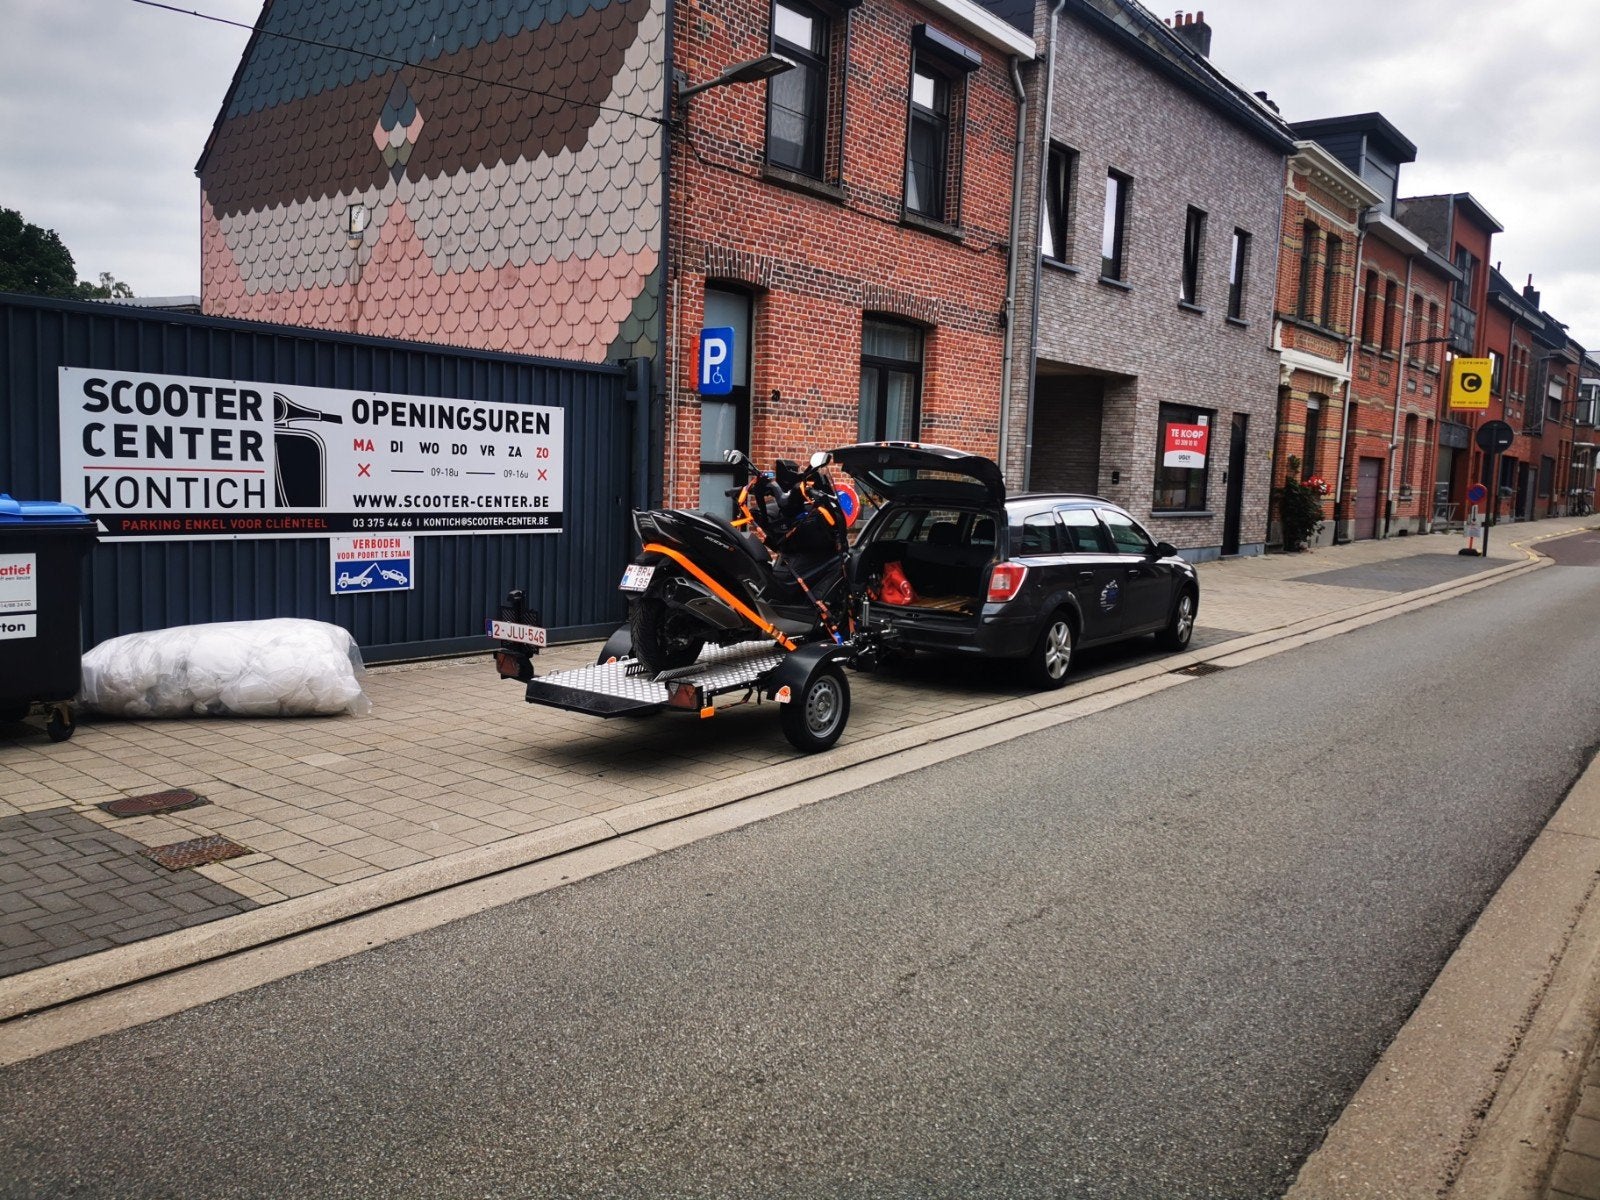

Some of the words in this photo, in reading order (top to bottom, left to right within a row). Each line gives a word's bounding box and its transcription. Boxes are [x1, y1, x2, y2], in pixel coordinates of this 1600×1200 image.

[703, 338, 727, 384] P
[82, 377, 264, 422] SCOOTER
[351, 398, 550, 435] OPENINGSUREN
[1171, 429, 1179, 437] TE
[1181, 430, 1203, 438] KOOP
[82, 422, 264, 462] CENTER
[353, 438, 375, 452] MA
[390, 440, 403, 453] DI
[419, 441, 440, 454] WO
[451, 443, 468, 455] DO
[480, 445, 495, 457] VR
[508, 446, 523, 458] ZA
[536, 447, 549, 459] ZO
[430, 467, 459, 477] 09-18u
[503, 469, 529, 479] 09-16u
[84, 475, 266, 509] KONTICH
[352, 494, 549, 508] WWW.SCOOTER-CENTER.BE
[122, 519, 182, 531] PARKING
[185, 519, 227, 530] ENKEL
[230, 518, 262, 529] VOOR
[265, 516, 328, 529] CLIËNTEEL
[352, 519, 364, 528] 03
[367, 518, 385, 527] 375
[387, 518, 399, 527] 44
[401, 518, 412, 527] 66
[423, 516, 549, 527] KONTICH@SCOOTER-CENTER.BE
[353, 538, 401, 549] VERBODEN
[337, 552, 355, 560] VOOR
[357, 551, 379, 559] POORT
[380, 550, 388, 558] TE
[390, 550, 411, 558] STAAN
[0, 623, 26, 632] ton
